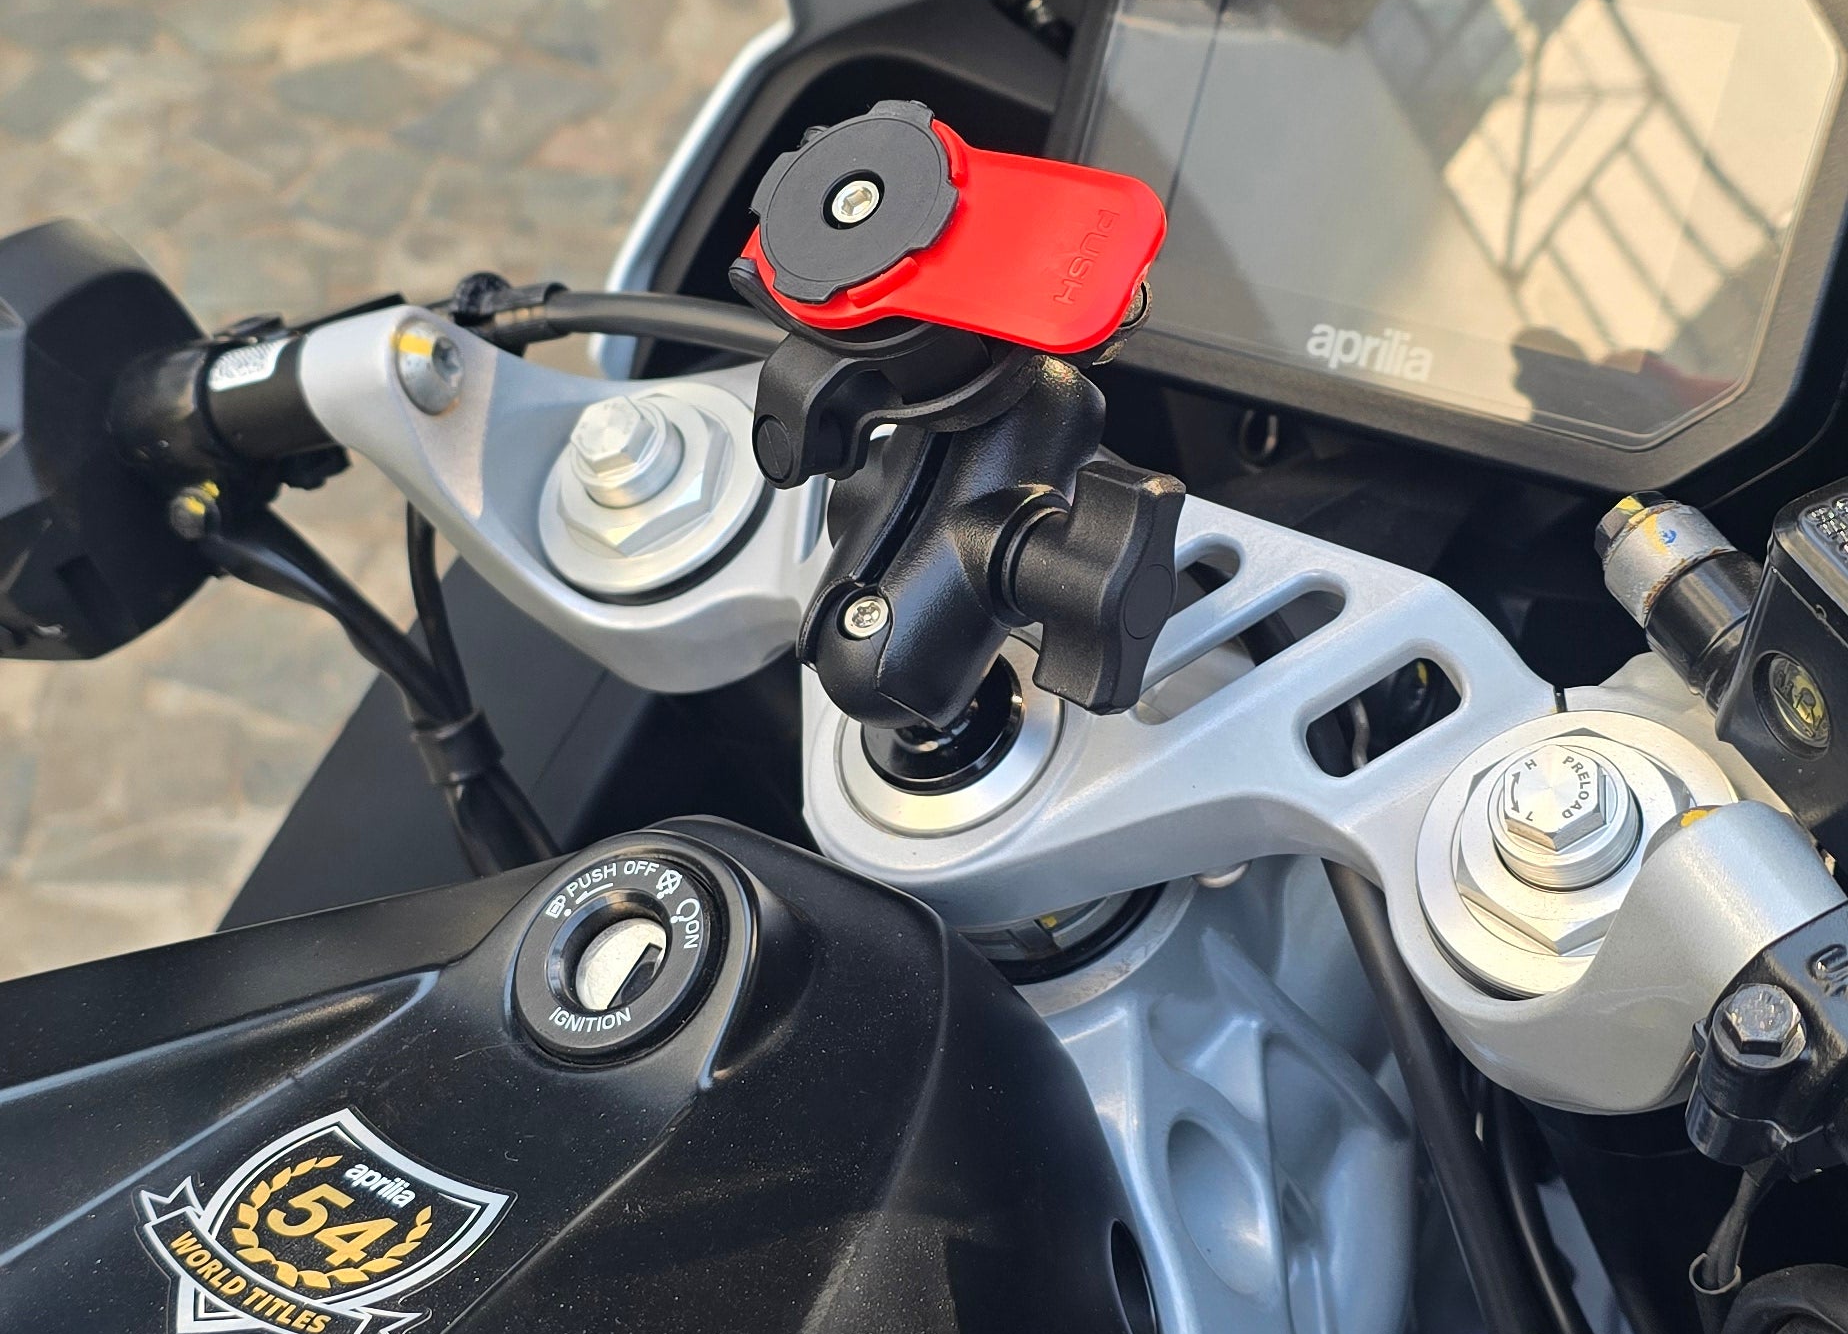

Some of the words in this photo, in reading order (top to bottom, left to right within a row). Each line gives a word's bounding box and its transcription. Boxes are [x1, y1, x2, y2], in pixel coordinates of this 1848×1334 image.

[1053, 209, 1121, 305] PUSH
[1307, 323, 1433, 381] aprilia
[1562, 756, 1591, 819] PRELOAD
[567, 863, 617, 898] PUSH
[623, 860, 660, 877] OFF
[684, 920, 699, 950] ON
[549, 1006, 631, 1033] IGNITION
[344, 1163, 416, 1208] aprilia
[266, 1184, 398, 1267] 54
[170, 1231, 247, 1296] WORLD
[241, 1287, 331, 1334] TITLES
